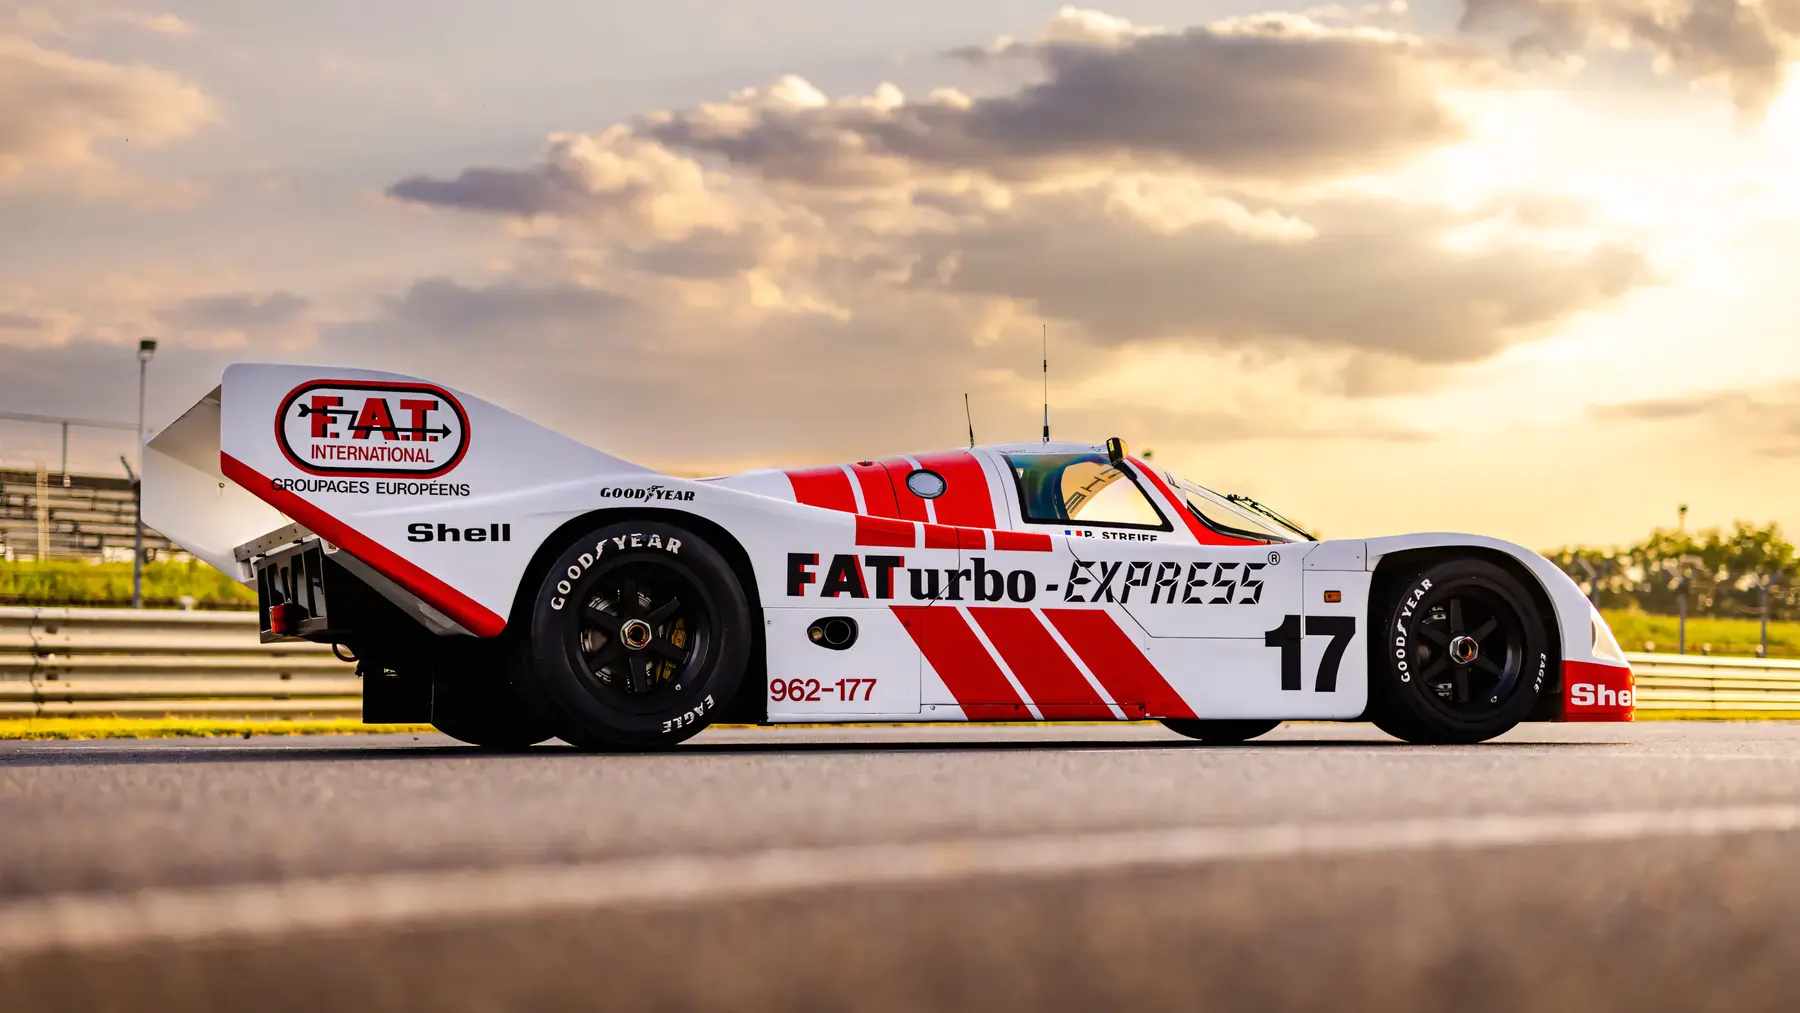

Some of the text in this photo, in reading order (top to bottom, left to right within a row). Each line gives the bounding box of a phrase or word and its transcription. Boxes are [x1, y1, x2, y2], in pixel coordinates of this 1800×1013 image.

[311, 444, 435, 463] INTERNATIONAL
[271, 477, 471, 497] GROUPAGES EUROPÉENS
[600, 486, 696, 502] GOODYEAR
[407, 523, 511, 542] Shell
[1395, 578, 1433, 683] GOODYEAR
[1264, 614, 1356, 693] 17
[1533, 652, 1547, 694] EAGLE
[769, 678, 877, 702] 962-177
[662, 694, 715, 734] EAGLE
